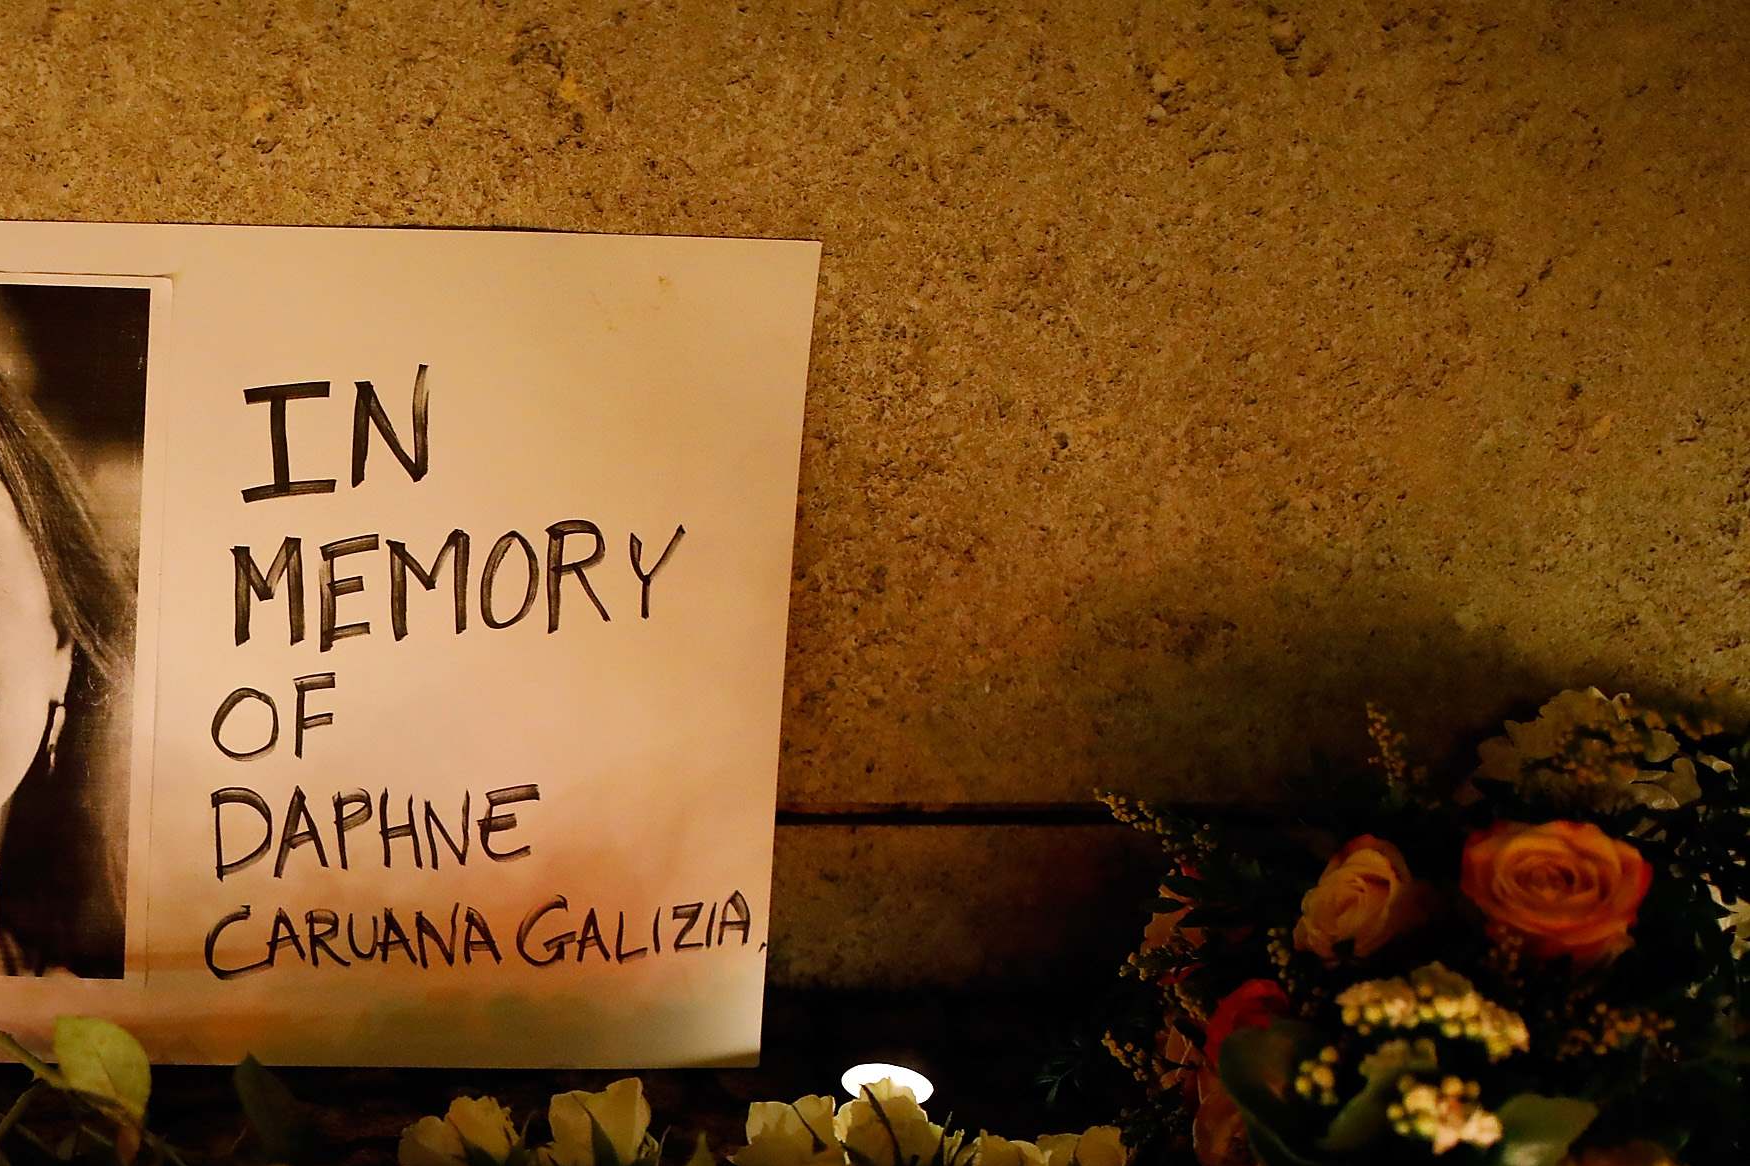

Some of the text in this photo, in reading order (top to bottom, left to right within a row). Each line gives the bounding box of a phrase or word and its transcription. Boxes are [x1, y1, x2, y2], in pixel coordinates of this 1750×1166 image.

[240, 363, 430, 504] IN
[229, 519, 687, 653] MEMORY
[210, 671, 337, 762] OF
[210, 783, 541, 883] DAPHNE
[203, 902, 504, 981] CARUANA
